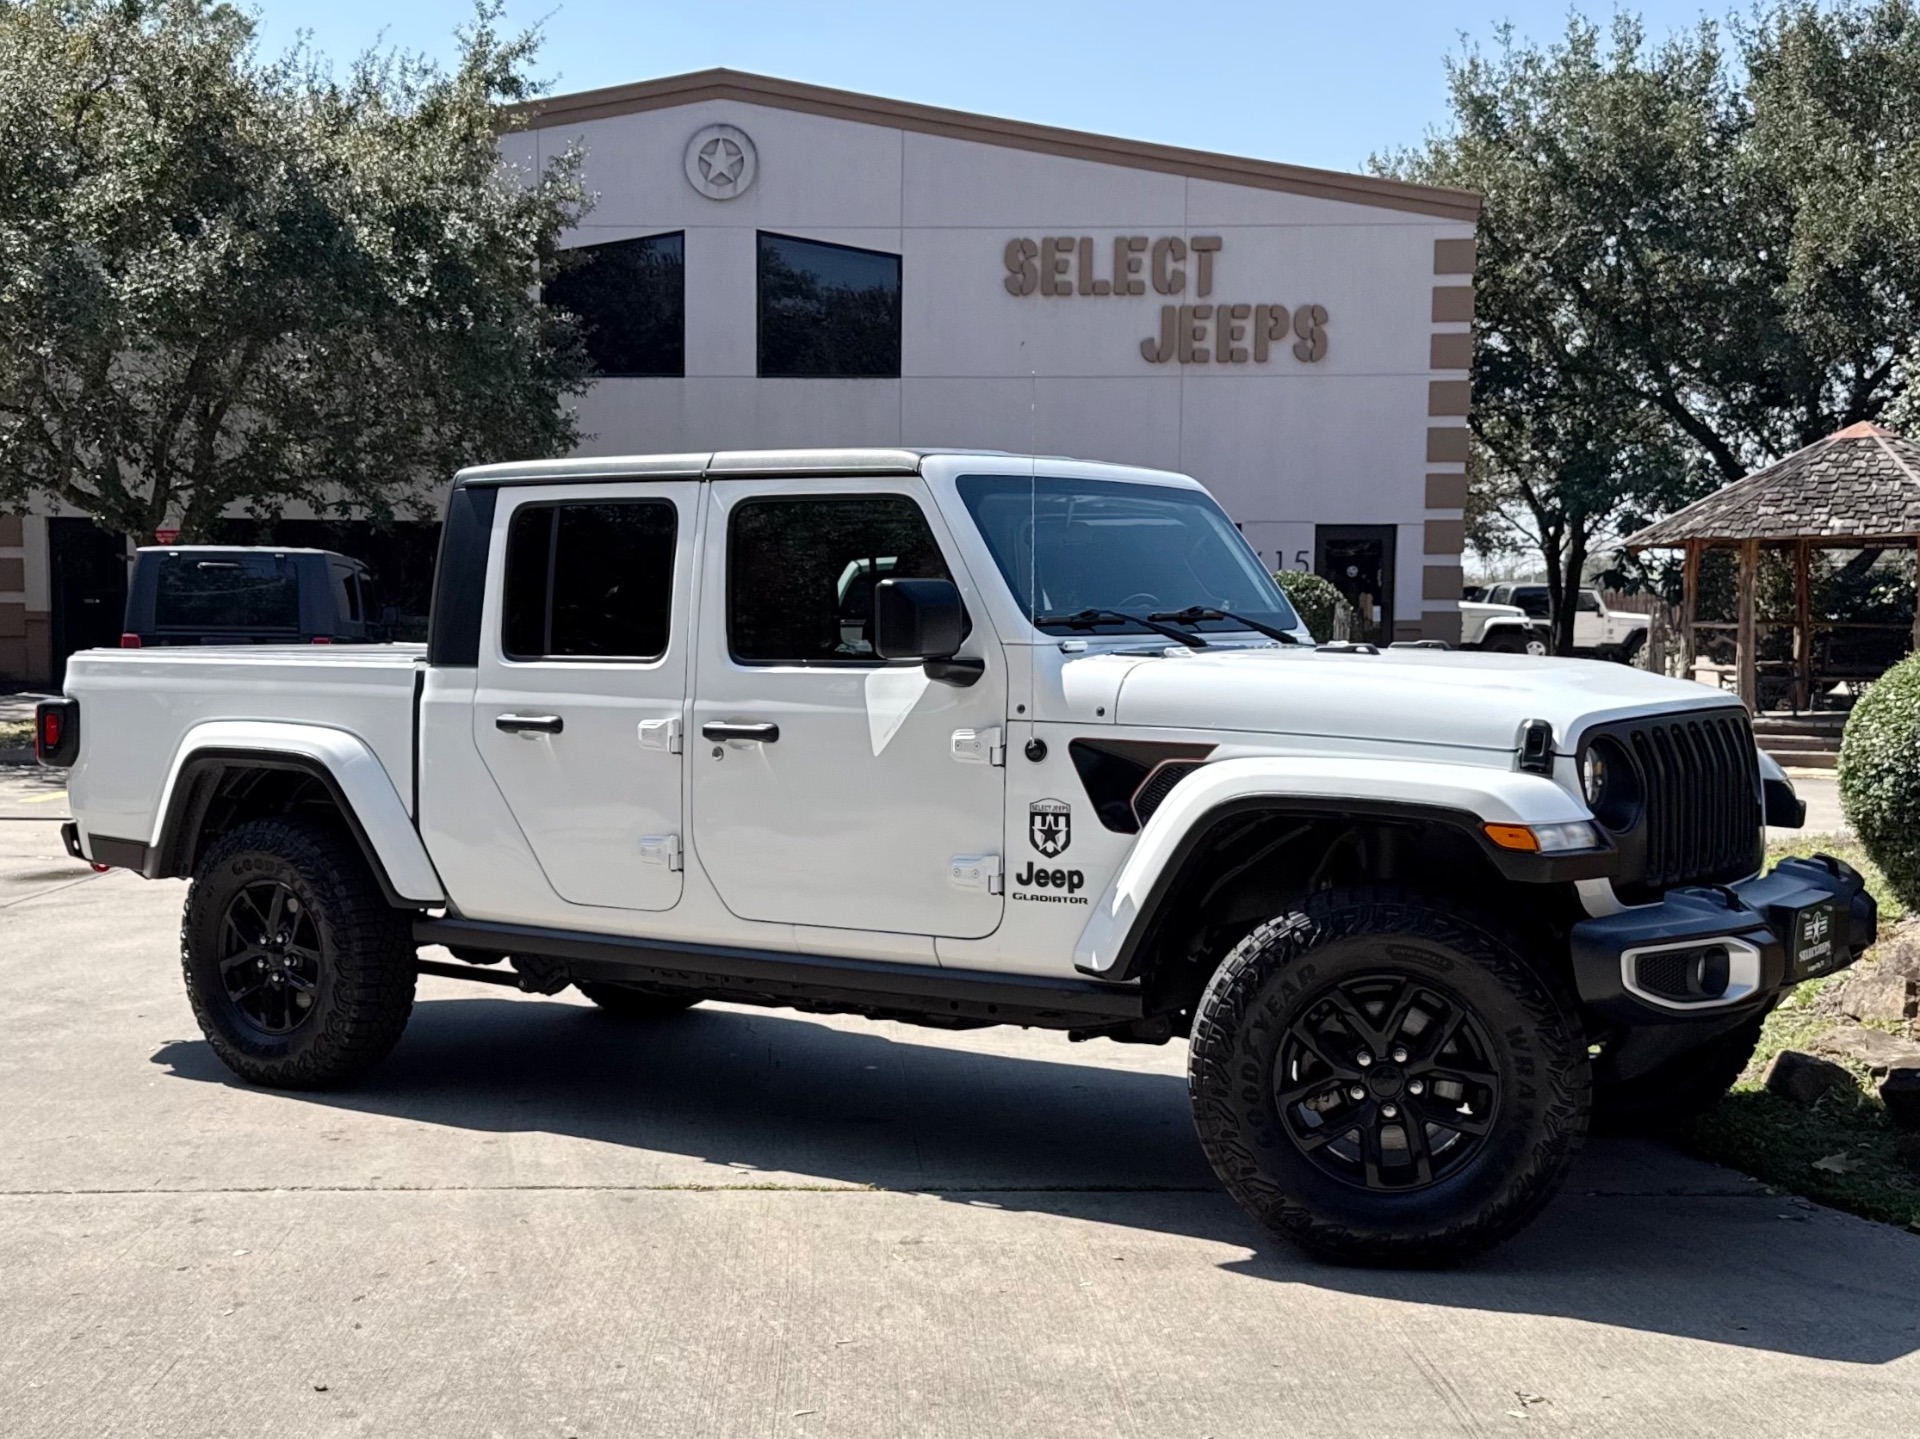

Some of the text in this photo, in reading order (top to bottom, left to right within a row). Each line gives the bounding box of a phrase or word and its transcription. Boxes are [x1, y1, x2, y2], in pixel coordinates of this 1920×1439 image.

[1004, 236, 1223, 297] SELECT
[1140, 304, 1328, 363] JEEPS
[1031, 804, 1070, 813] SELECT JEEPS
[1016, 861, 1084, 893] Jeep
[1012, 892, 1088, 904] GLADIATOR
